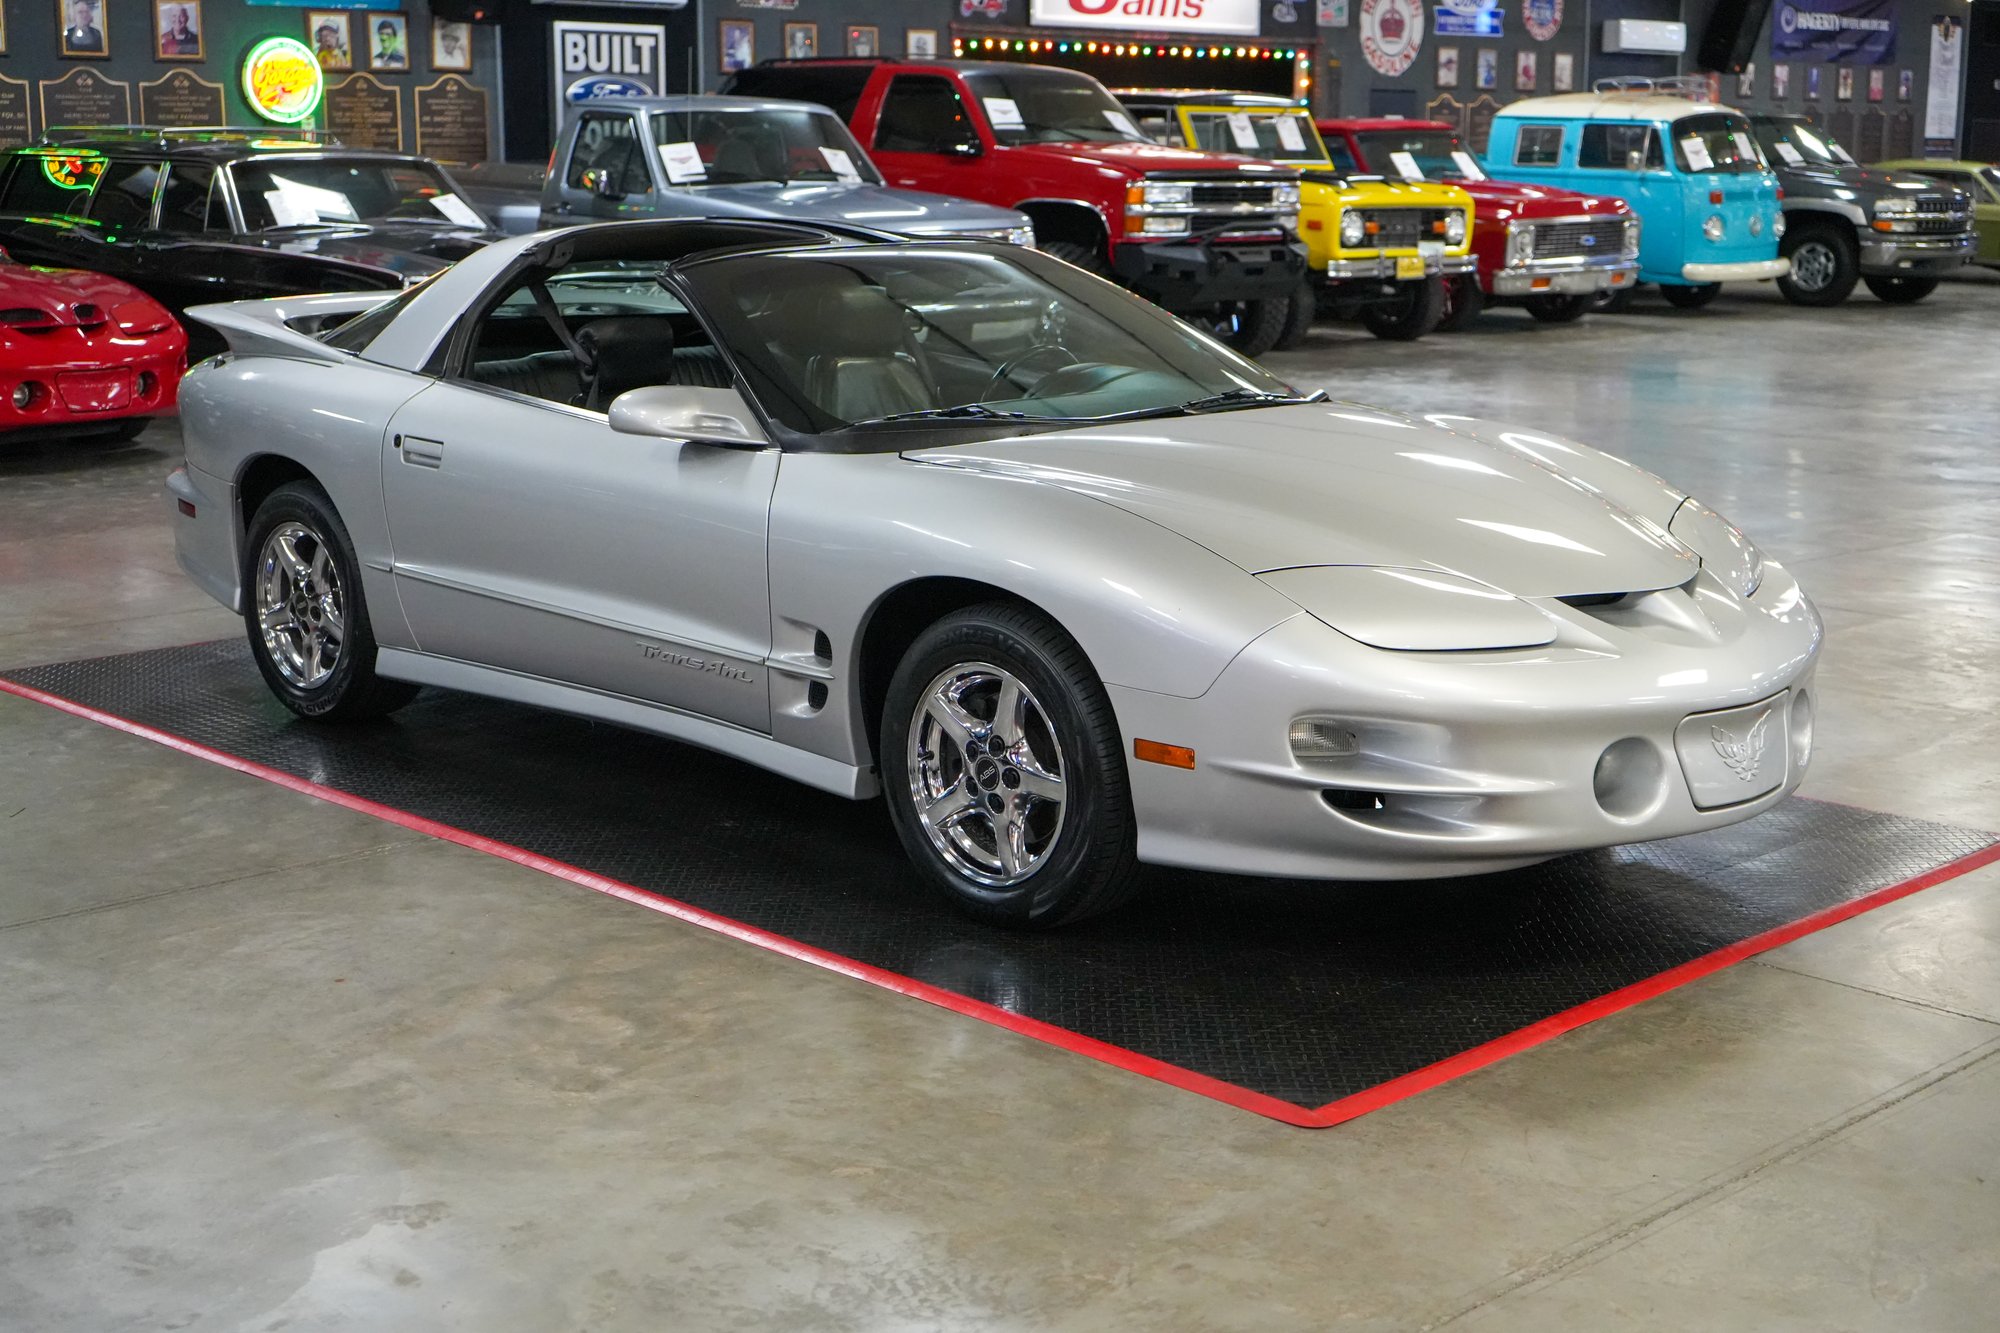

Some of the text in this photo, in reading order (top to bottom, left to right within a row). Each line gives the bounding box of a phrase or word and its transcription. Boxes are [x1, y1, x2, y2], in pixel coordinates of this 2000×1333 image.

[564, 32, 657, 75] BUILT
[635, 641, 754, 684] Trans Am
[980, 765, 996, 783] ABS
